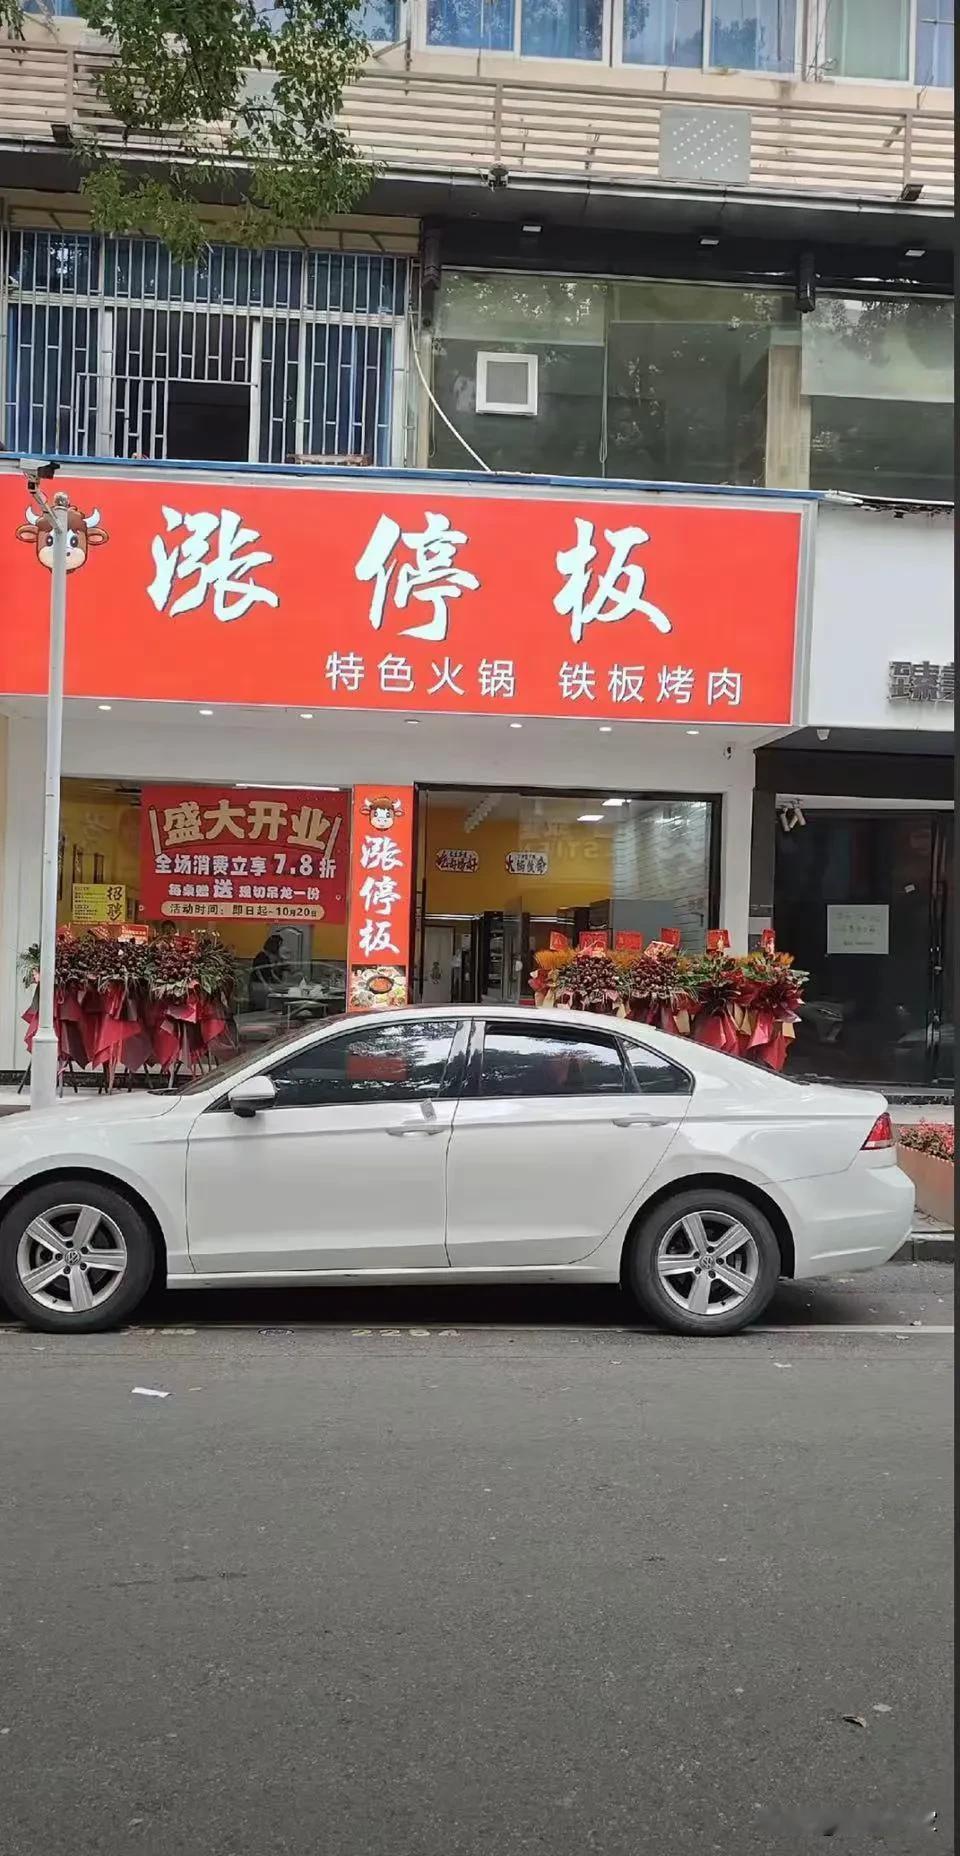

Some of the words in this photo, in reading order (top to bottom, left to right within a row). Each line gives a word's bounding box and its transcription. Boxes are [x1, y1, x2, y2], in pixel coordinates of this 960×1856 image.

[146, 504, 673, 644] 涨停板
[324, 651, 516, 700] 特色火锅
[558, 660, 743, 707] 铁板烤肉
[162, 798, 332, 851] 盛大开业
[106, 886, 123, 921] 招聘
[358, 835, 405, 959] 涨停板
